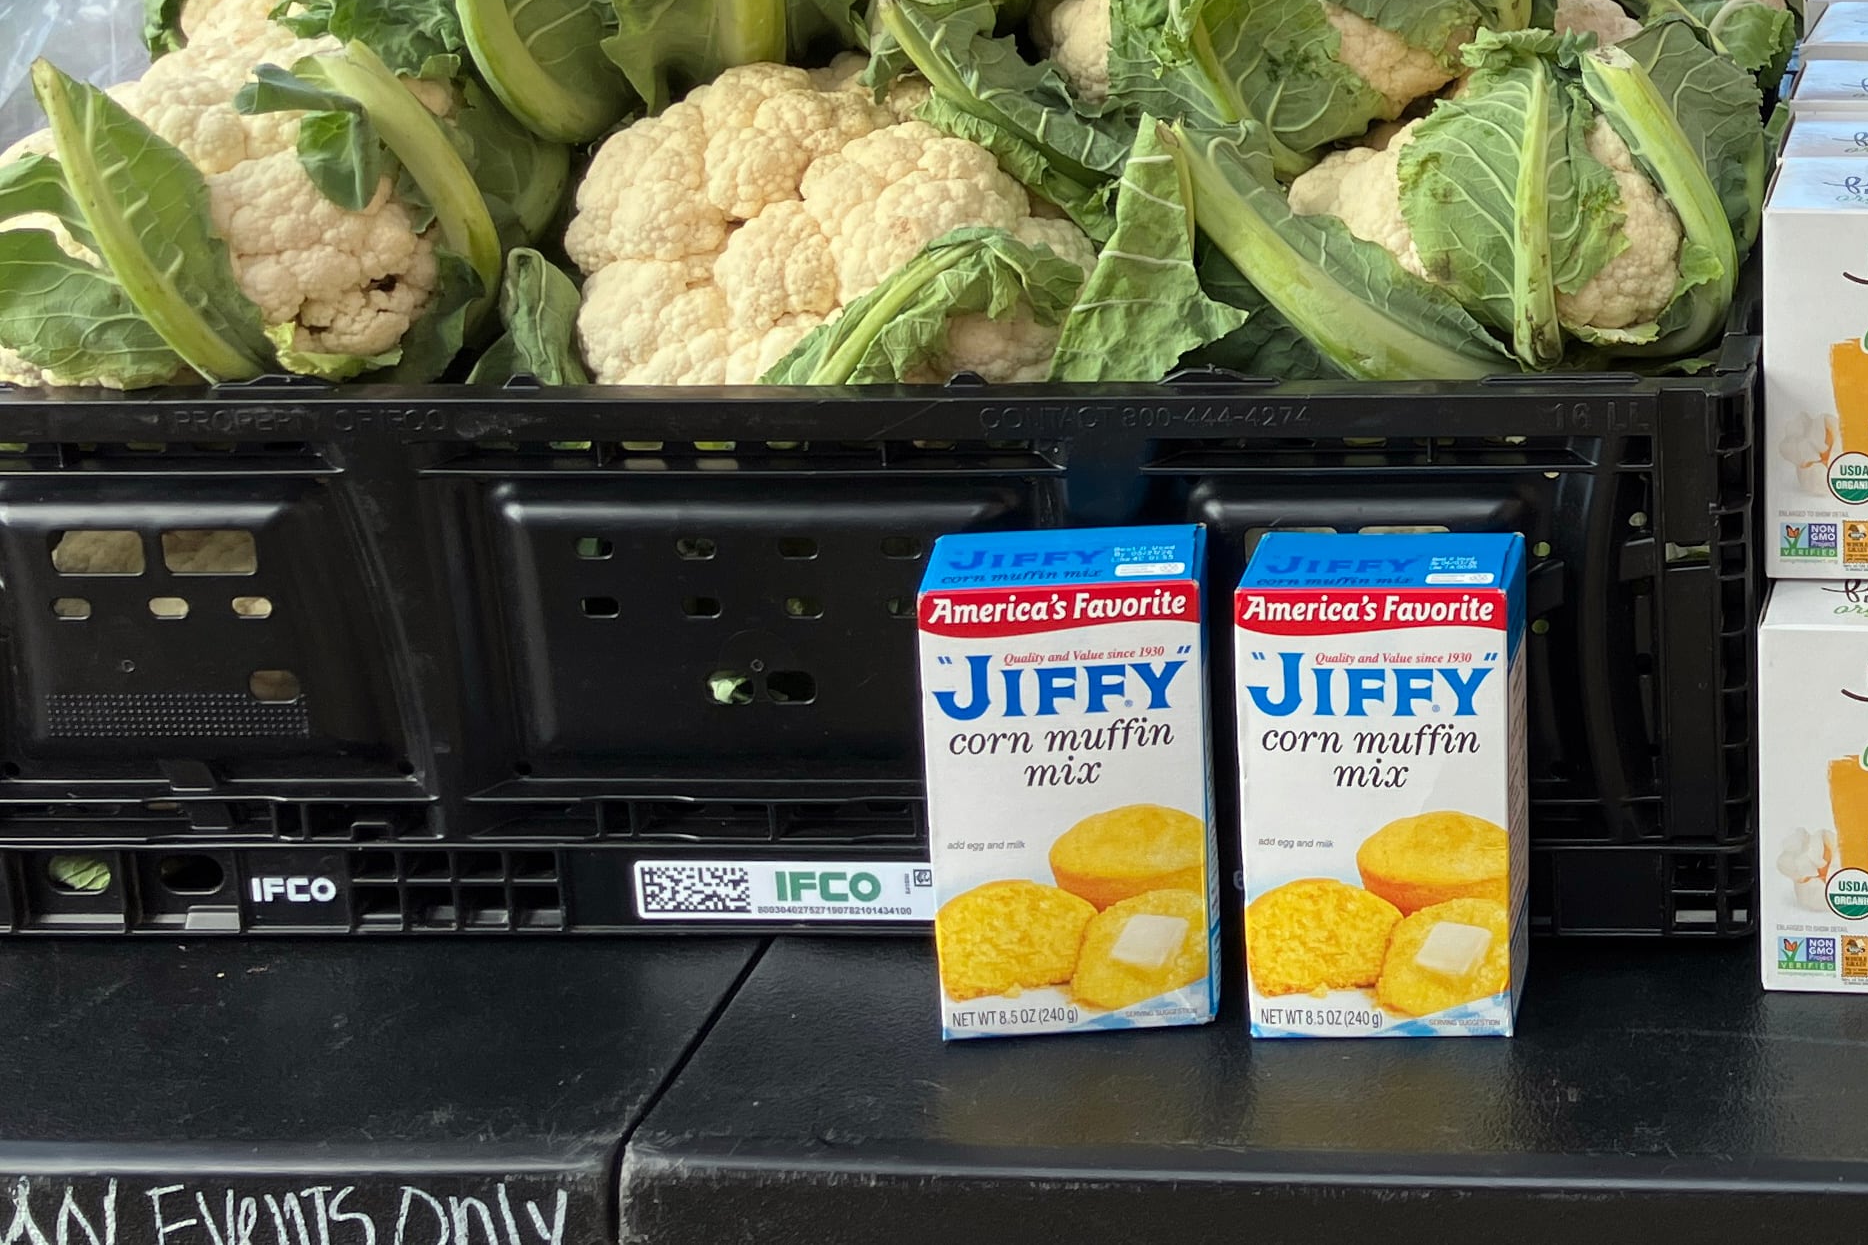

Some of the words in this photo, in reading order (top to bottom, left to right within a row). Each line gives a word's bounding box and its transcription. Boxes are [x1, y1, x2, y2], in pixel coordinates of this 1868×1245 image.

[927, 593, 1067, 624] America's
[1073, 588, 1187, 619] Favorite
[1242, 595, 1378, 622] America's
[1383, 594, 1494, 622] Favorite
[1003, 652, 1045, 667] Quality
[1048, 651, 1069, 662] and
[1073, 650, 1104, 662] Value
[1107, 649, 1135, 660] since
[1139, 646, 1164, 657] 1930
[1315, 653, 1356, 664] Quality
[1358, 653, 1379, 664] and
[1382, 653, 1412, 664] Value
[1416, 653, 1444, 664] since
[1447, 653, 1472, 663] 1930
[949, 730, 1033, 755] corn
[1044, 717, 1174, 752] muffin
[1261, 730, 1343, 753] corn
[1353, 723, 1481, 756] muffin
[1023, 755, 1102, 787] mix
[1333, 758, 1409, 787] mix
[947, 841, 965, 850] add
[967, 840, 984, 853] egg
[986, 841, 1005, 850] and
[1007, 840, 1026, 850] milk
[251, 877, 337, 902] IFCO
[775, 871, 881, 902] IFCO
[1837, 879, 1868, 893] USDA
[951, 1013, 974, 1028] NET
[976, 1012, 997, 1026] WT
[998, 1011, 1019, 1025] 8.5
[1021, 1010, 1038, 1024] OZ
[1039, 1010, 1063, 1025] (240
[1066, 1008, 1079, 1024] g)
[1260, 1010, 1281, 1026] NET
[1283, 1010, 1304, 1026] WT
[1305, 1010, 1325, 1026] 8.5
[1327, 1010, 1342, 1027] OZ
[1344, 1010, 1367, 1028] (240
[1370, 1011, 1383, 1028] g)
